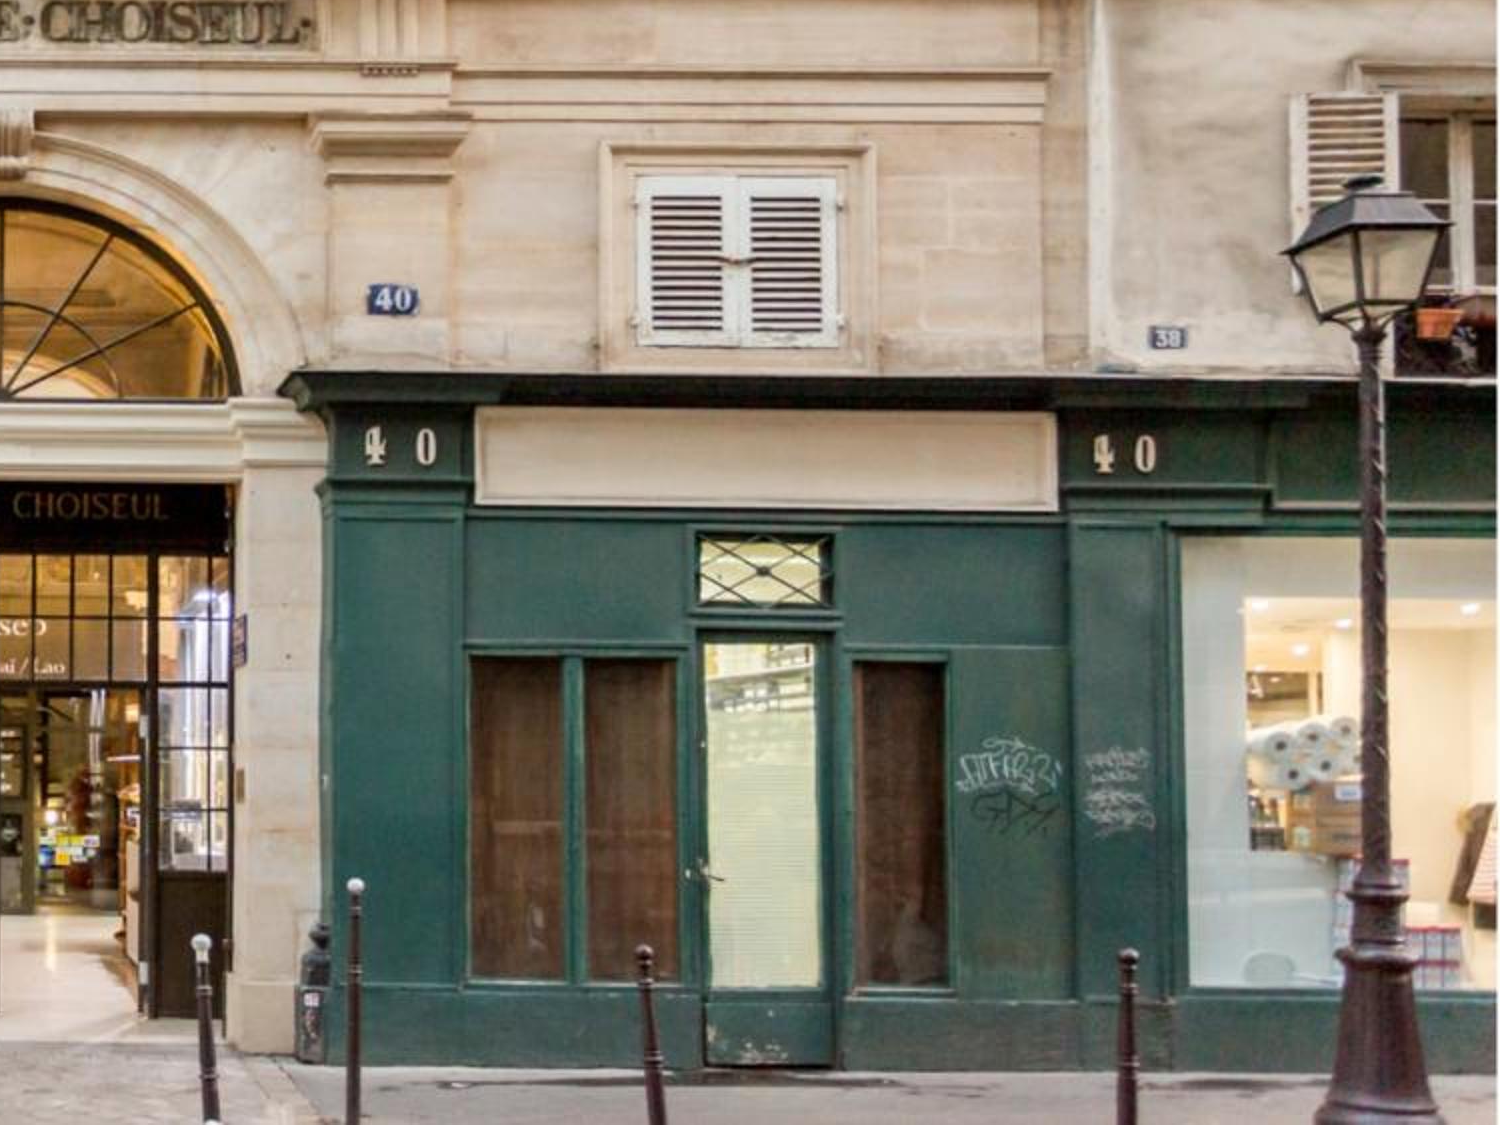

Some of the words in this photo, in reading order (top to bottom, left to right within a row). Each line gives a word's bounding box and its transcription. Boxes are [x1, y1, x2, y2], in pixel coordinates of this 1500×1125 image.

[40, 0, 300, 44] CHOISEUL
[374, 286, 413, 312] 40
[1155, 329, 1182, 349] 38
[12, 491, 170, 520] CHOISEUL
